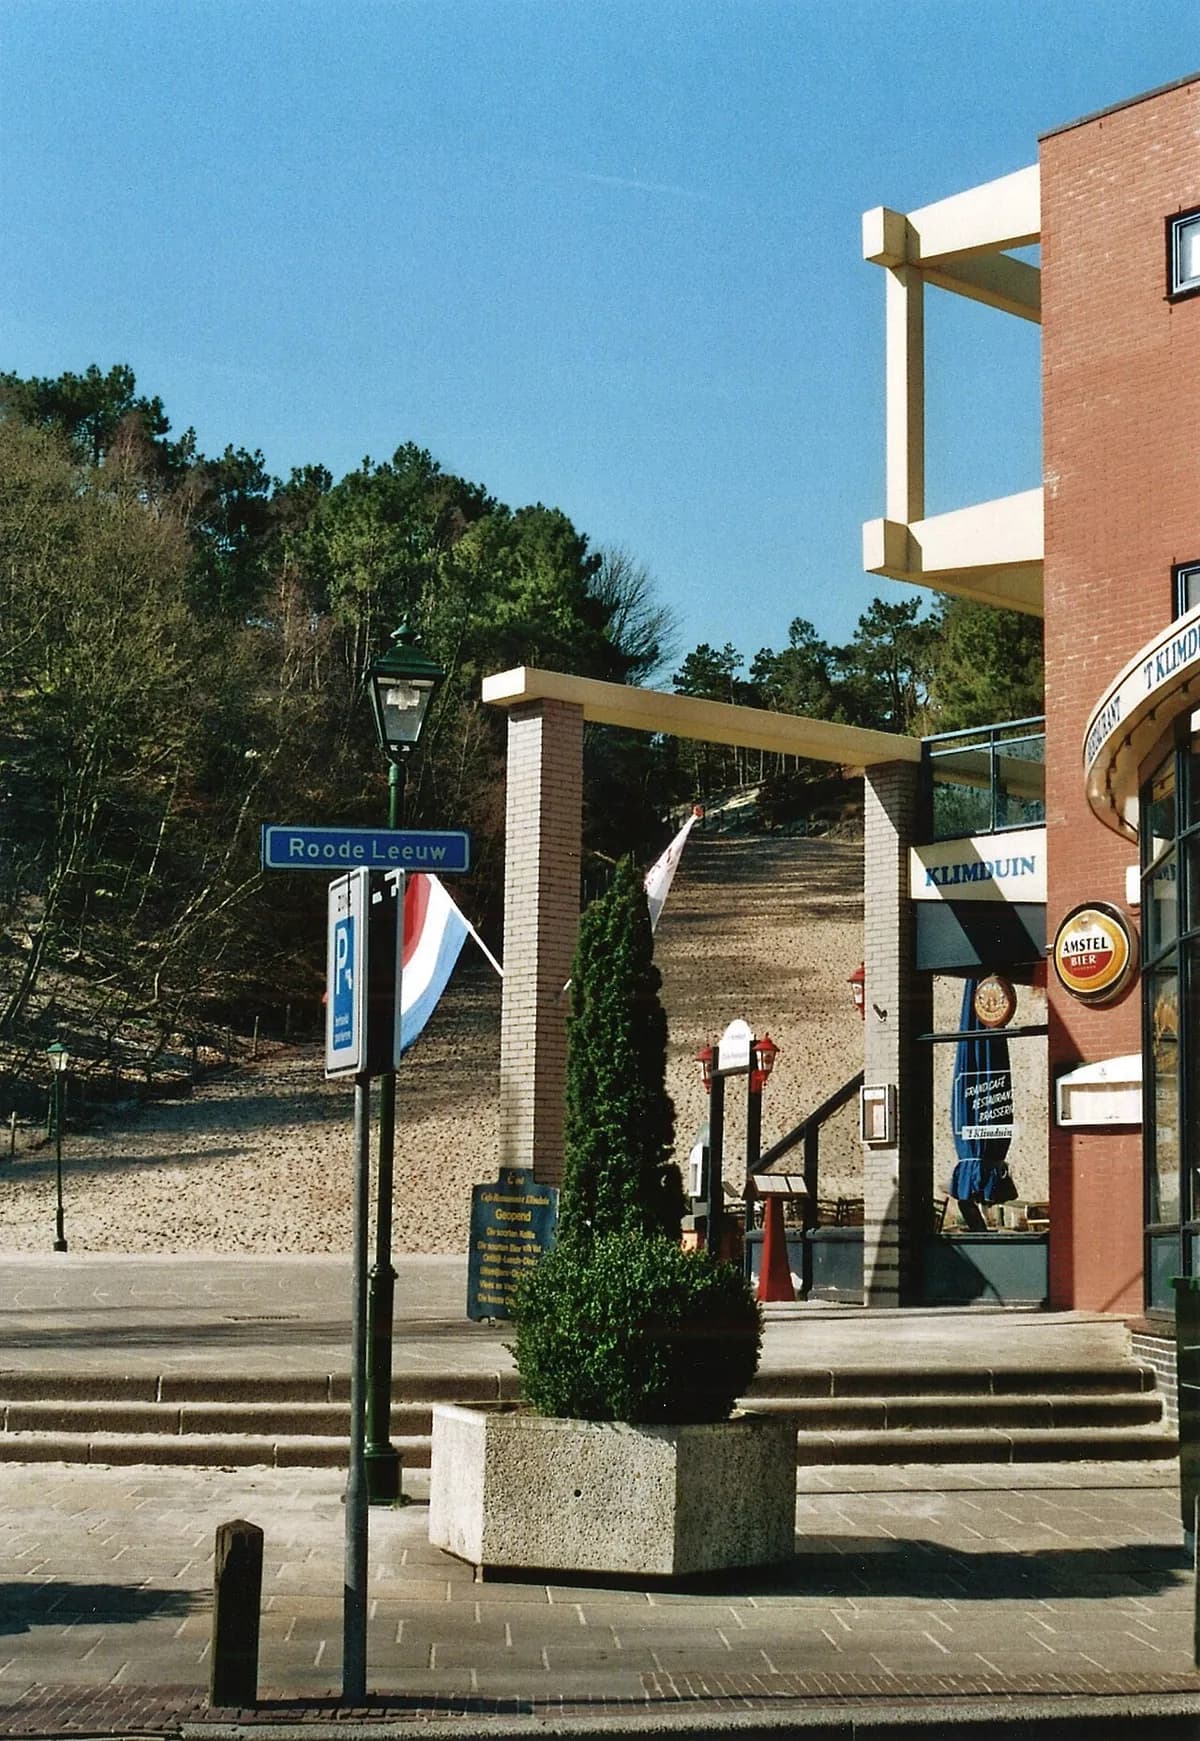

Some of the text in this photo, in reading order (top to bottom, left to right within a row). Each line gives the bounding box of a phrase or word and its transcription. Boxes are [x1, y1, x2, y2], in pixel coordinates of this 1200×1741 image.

[289, 838, 447, 861] Roode Leeuw
[925, 855, 1036, 887] KLIMDUIN
[1063, 936, 1109, 955] AMSTEL
[336, 927, 348, 995] P
[1070, 954, 1097, 967] BIER
